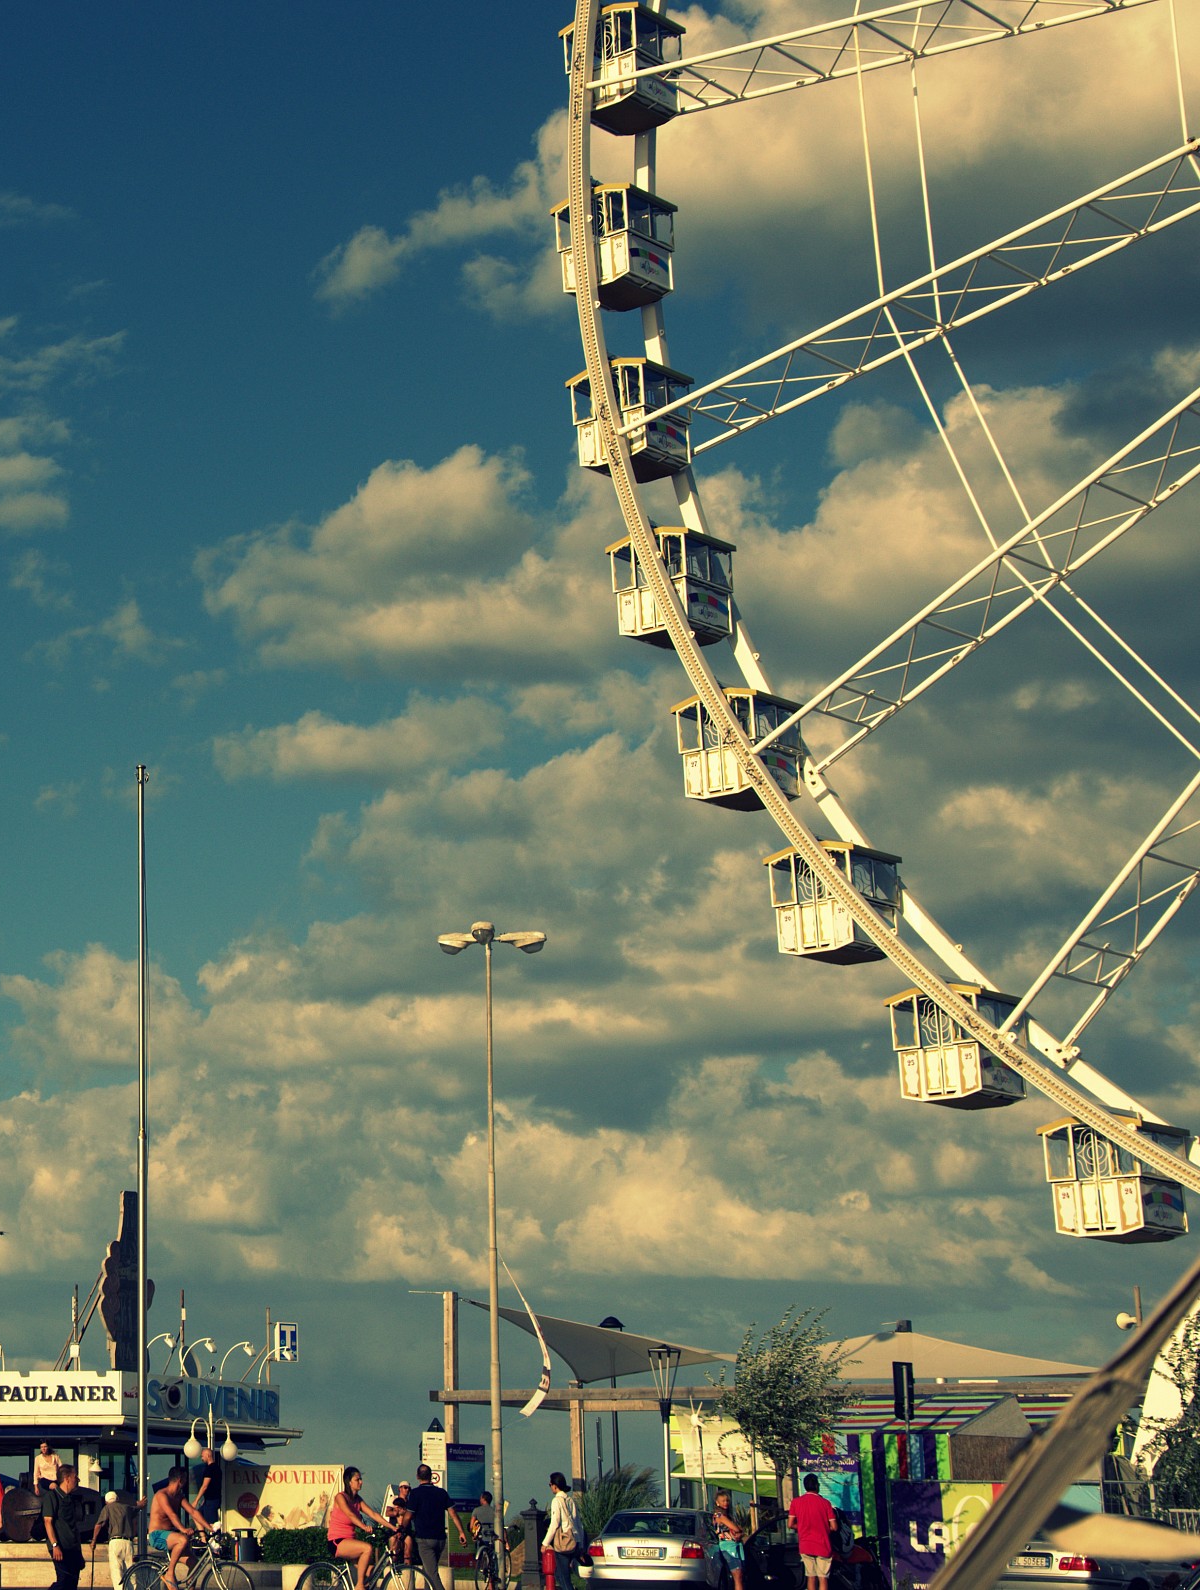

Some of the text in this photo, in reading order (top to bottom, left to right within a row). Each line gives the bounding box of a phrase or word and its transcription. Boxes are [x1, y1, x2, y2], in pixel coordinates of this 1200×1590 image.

[1124, 1187, 1133, 1195] 24
[1061, 1192, 1070, 1200] 24
[147, 1379, 279, 1425] SOUVENIR
[231, 1470, 335, 1484] BAR SOUVENIR
[626, 1549, 635, 1557] CP
